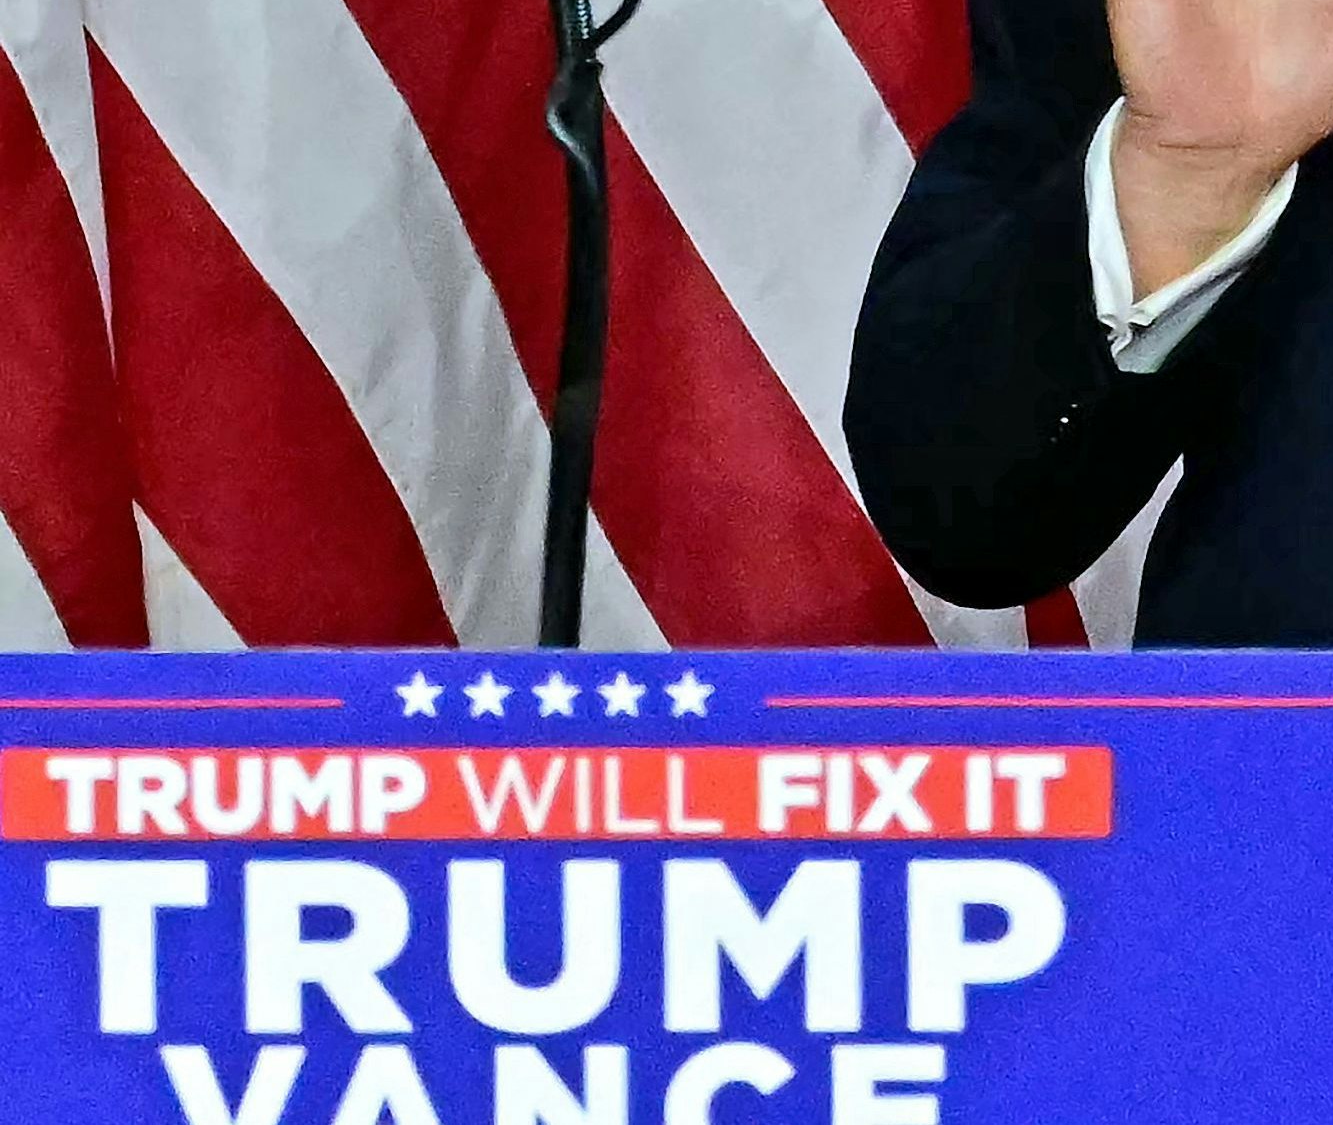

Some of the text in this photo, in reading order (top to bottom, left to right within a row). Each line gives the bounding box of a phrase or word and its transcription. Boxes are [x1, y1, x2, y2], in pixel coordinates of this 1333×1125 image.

[44, 751, 1068, 836] TRUMP WILL FIX IT
[44, 858, 1066, 1035] TRUMP
[158, 1041, 948, 1125] VANCE
